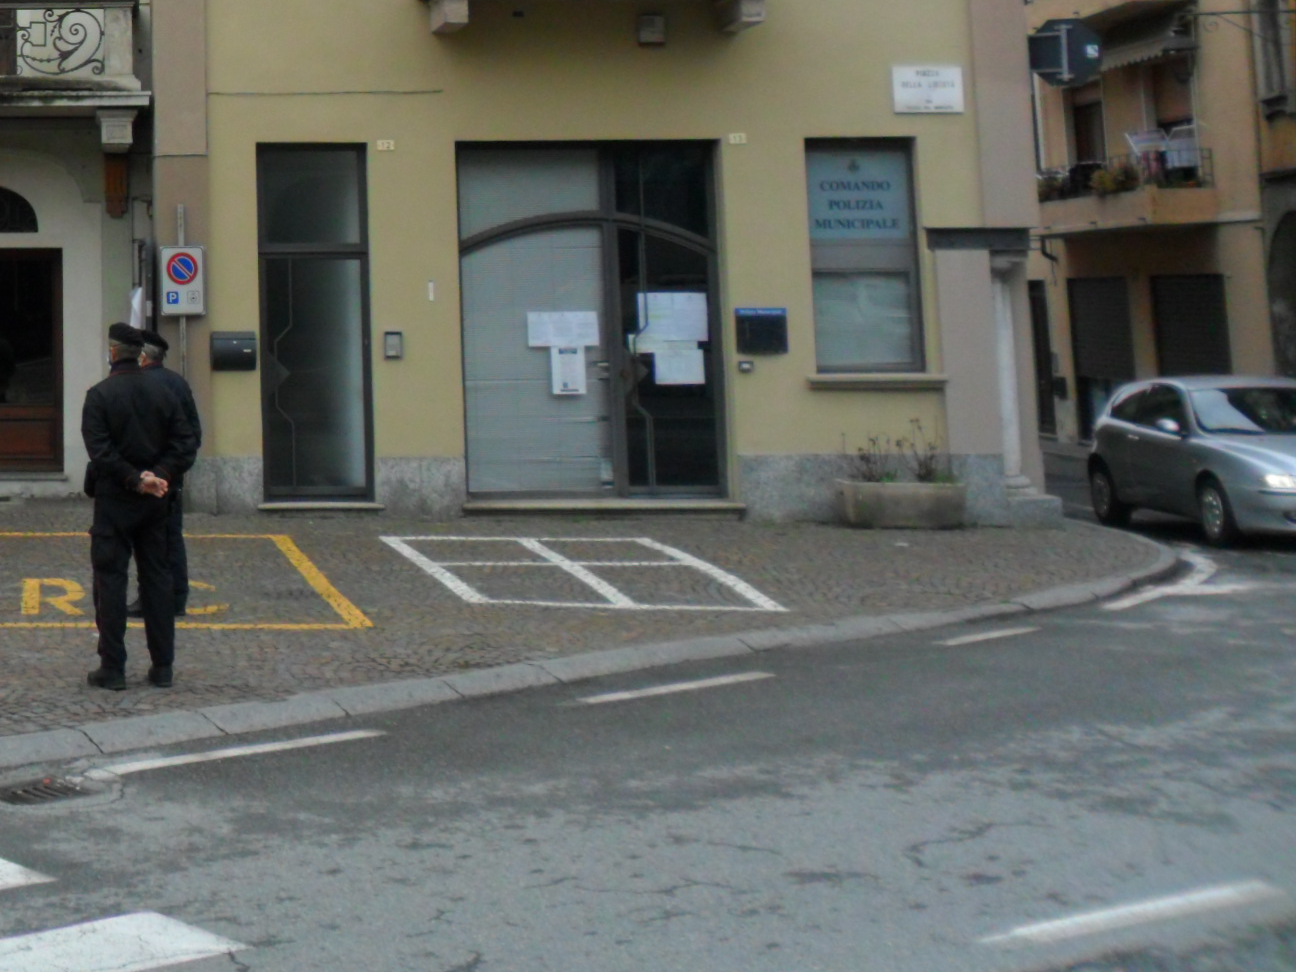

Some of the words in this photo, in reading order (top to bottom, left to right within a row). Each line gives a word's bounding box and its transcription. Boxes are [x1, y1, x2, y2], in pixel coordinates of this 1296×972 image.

[819, 180, 891, 191] COMANDO
[828, 199, 884, 210] POLIZIA
[814, 218, 899, 230] MUNICIPALE
[169, 292, 177, 303] P
